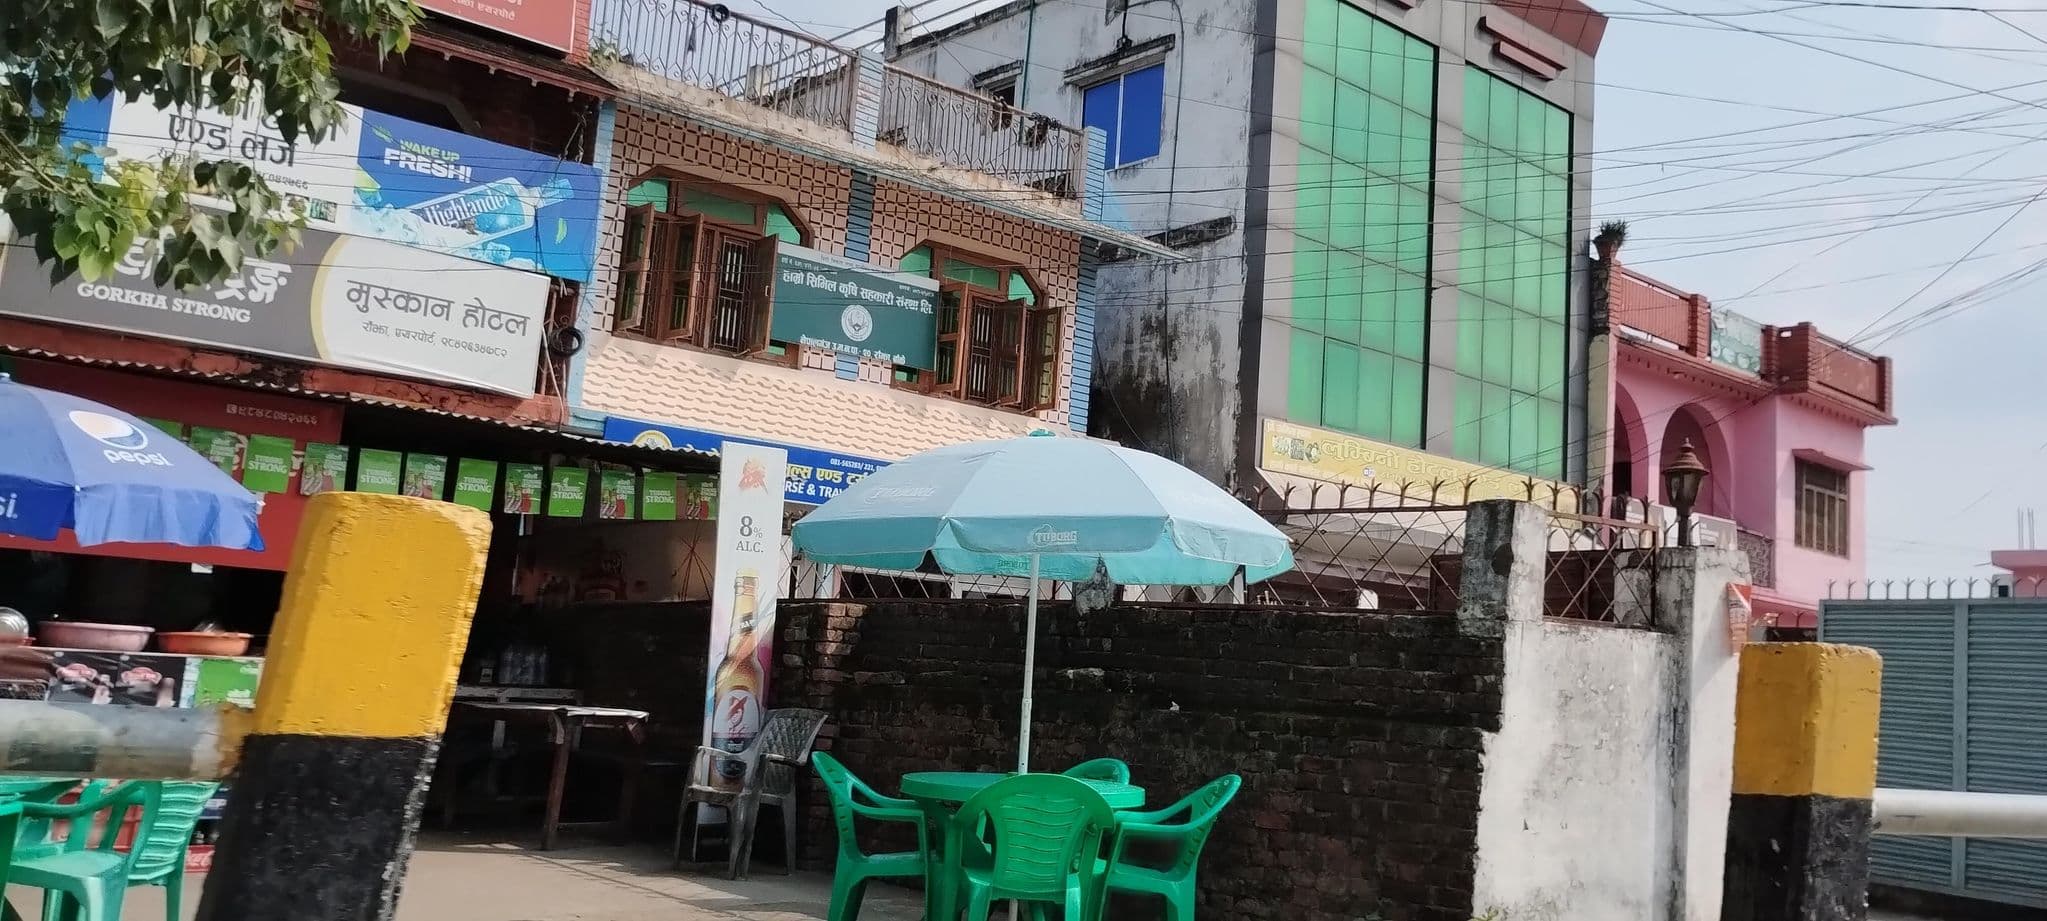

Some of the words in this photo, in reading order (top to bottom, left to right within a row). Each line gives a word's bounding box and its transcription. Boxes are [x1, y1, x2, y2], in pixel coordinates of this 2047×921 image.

[401, 139, 440, 159] WAKE
[442, 150, 460, 162] UP
[383, 147, 473, 184] FRESH!
[424, 187, 512, 227] Highlander
[783, 269, 804, 285] हाम्रो
[839, 281, 858, 298] कृषि
[860, 287, 894, 306] सहकारी
[77, 282, 168, 311] GORKHA
[172, 297, 251, 323] STRONG
[346, 279, 455, 321] मुस्कान
[462, 297, 530, 337] होटल
[104, 448, 174, 466] pepsi
[247, 460, 288, 474] STRONG
[360, 474, 397, 486] STRONG
[816, 468, 845, 485] एण्ड
[458, 482, 492, 494] STRONG
[551, 490, 584, 500] STRONG
[806, 483, 816, 496] &
[646, 495, 675, 504] STRONG
[1035, 530, 1078, 544] TUBORG
[735, 540, 764, 553] ALC.
